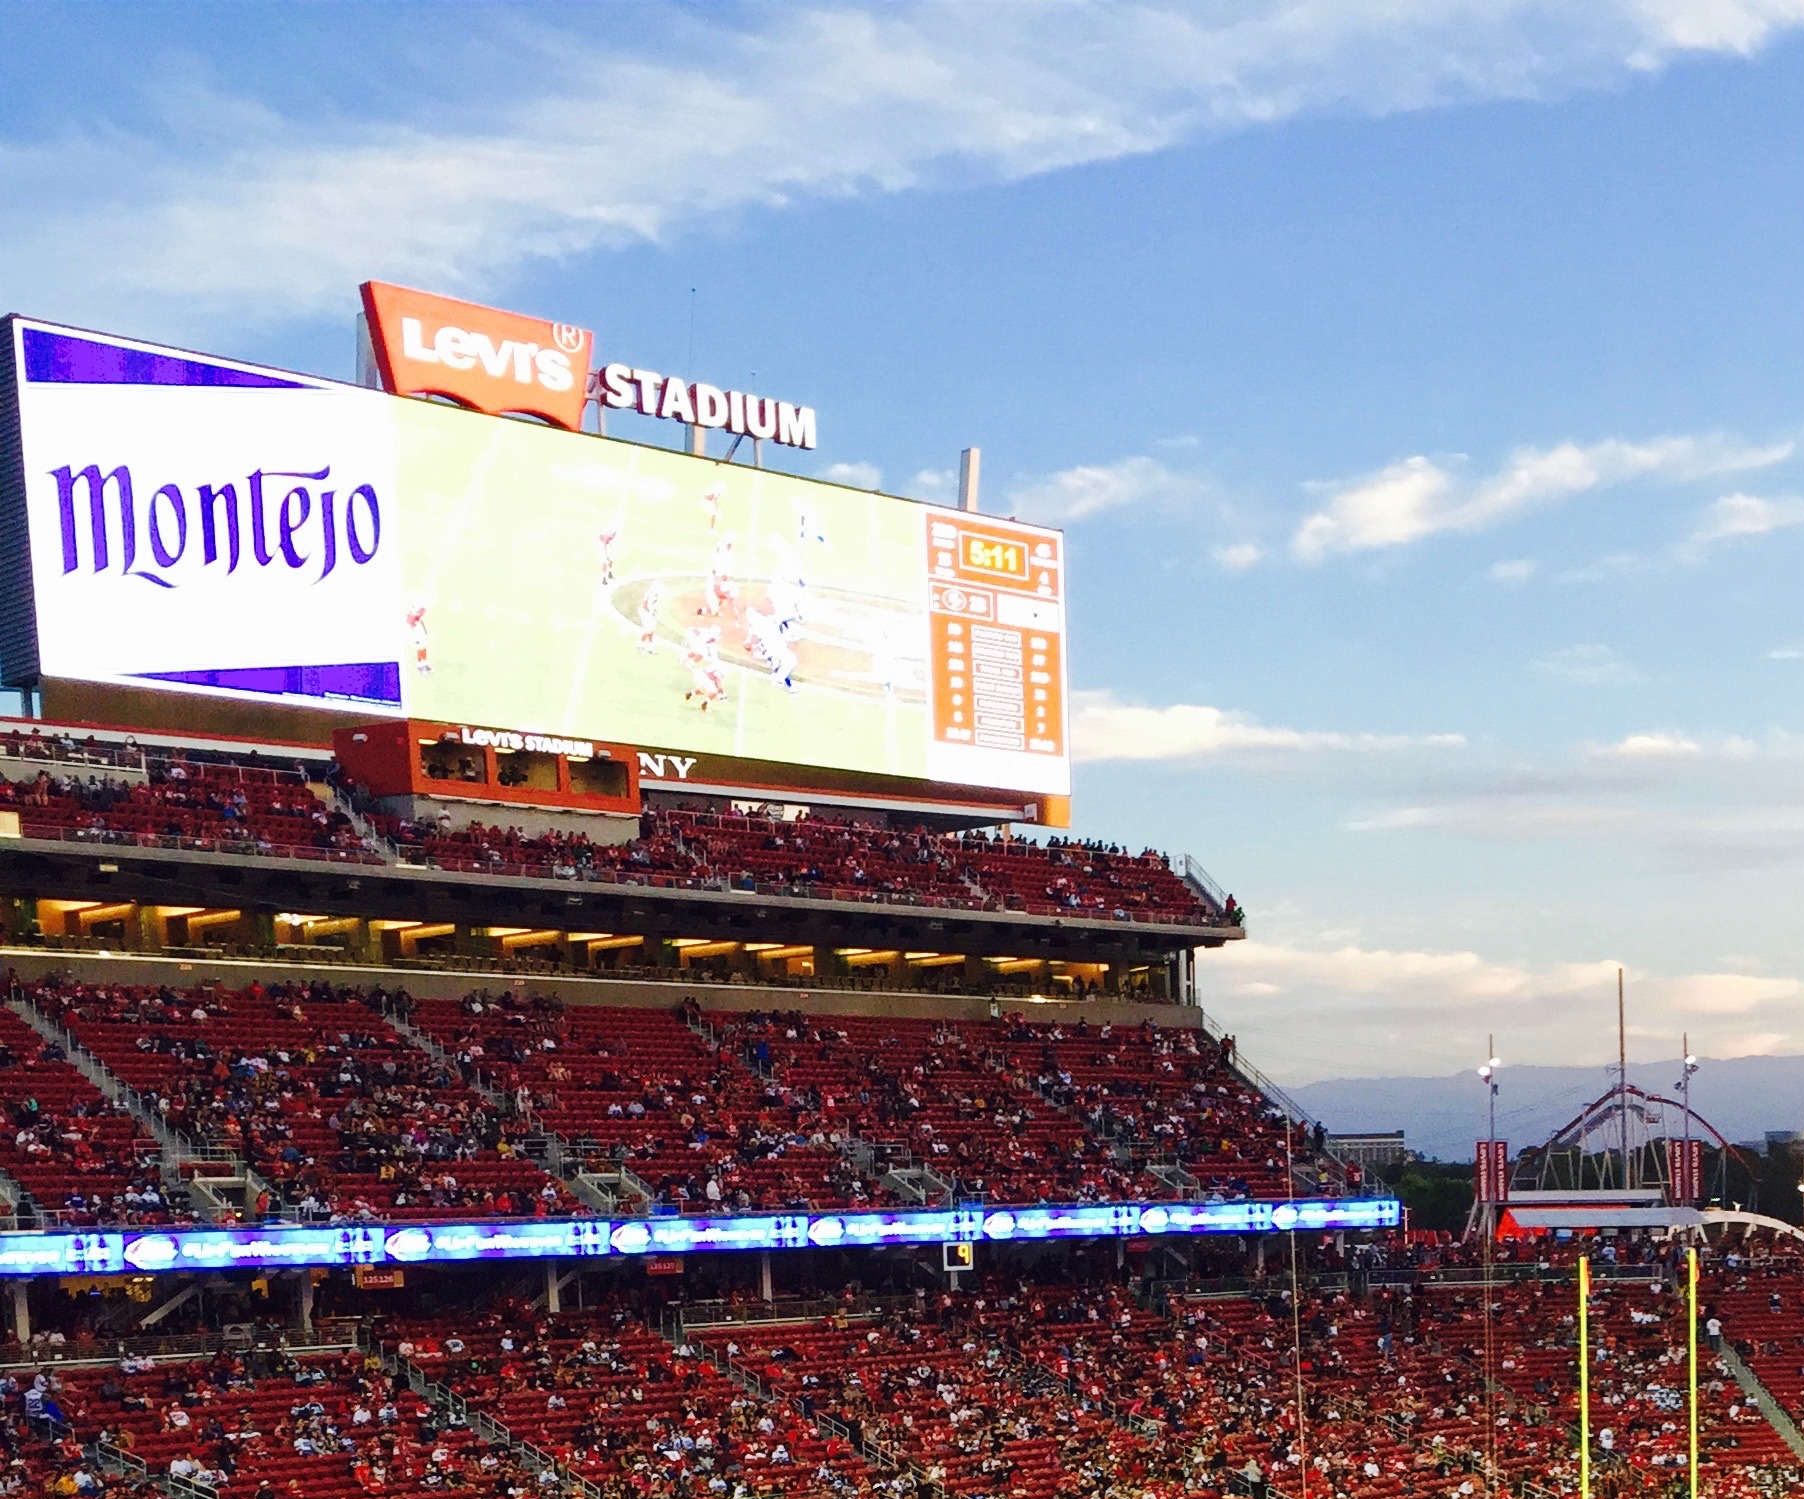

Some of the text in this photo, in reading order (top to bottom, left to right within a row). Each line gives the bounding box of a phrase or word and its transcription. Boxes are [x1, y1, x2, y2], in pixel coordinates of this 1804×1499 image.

[602, 362, 818, 449] STADIUM
[48, 463, 382, 588] Montejo
[968, 540, 1017, 571] 5:11
[525, 736, 593, 758] STADIUM
[636, 751, 698, 779] NY
[958, 1244, 970, 1264] 9
